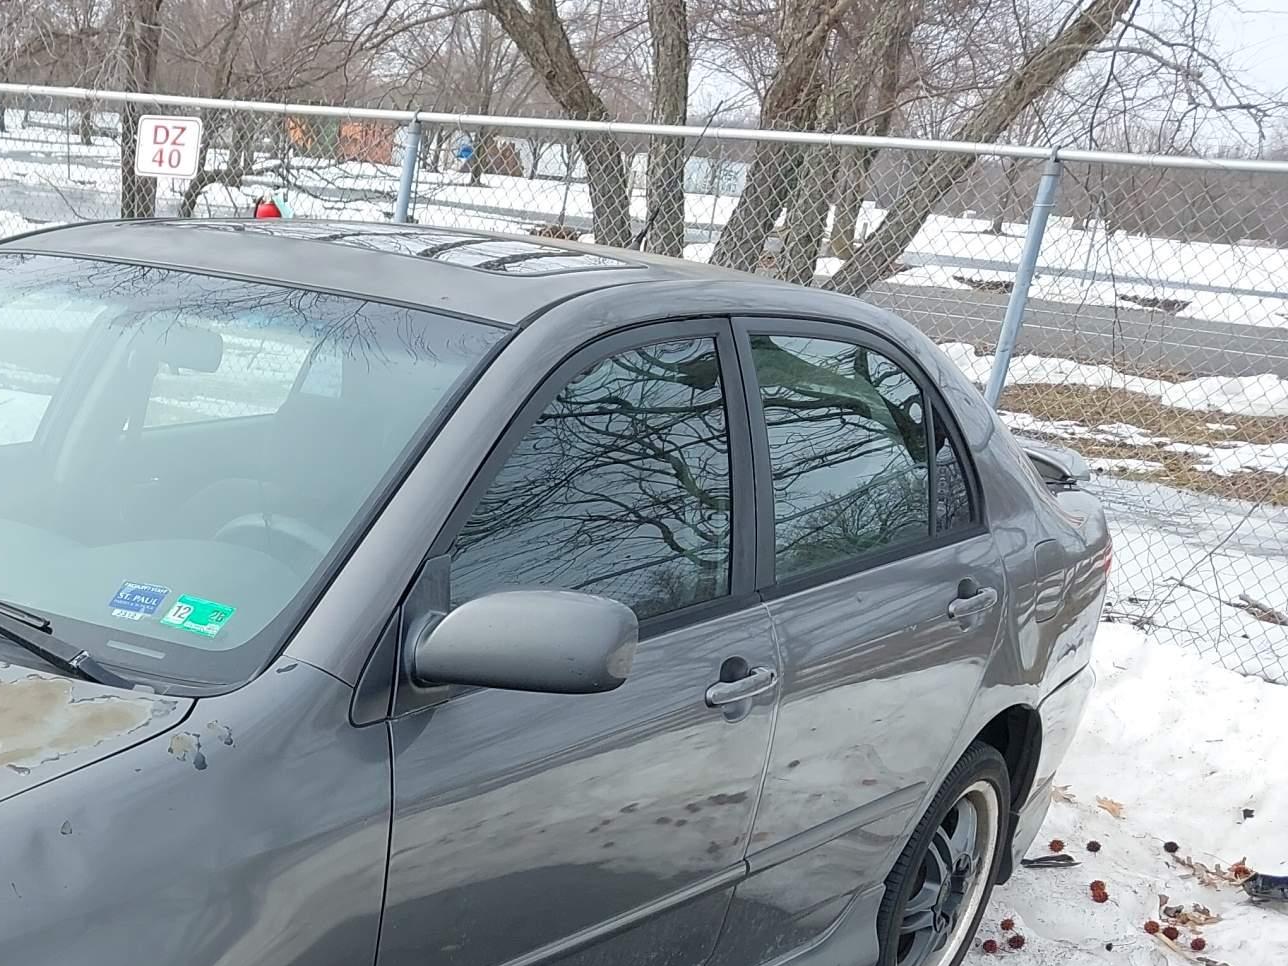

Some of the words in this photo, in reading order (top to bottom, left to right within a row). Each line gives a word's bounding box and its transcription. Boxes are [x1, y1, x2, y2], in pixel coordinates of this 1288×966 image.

[153, 125, 187, 146] DZ
[152, 148, 181, 168] 40
[117, 592, 130, 600] ST.
[133, 594, 159, 606] PAUL
[173, 605, 192, 619] 12
[210, 609, 226, 622] 26
